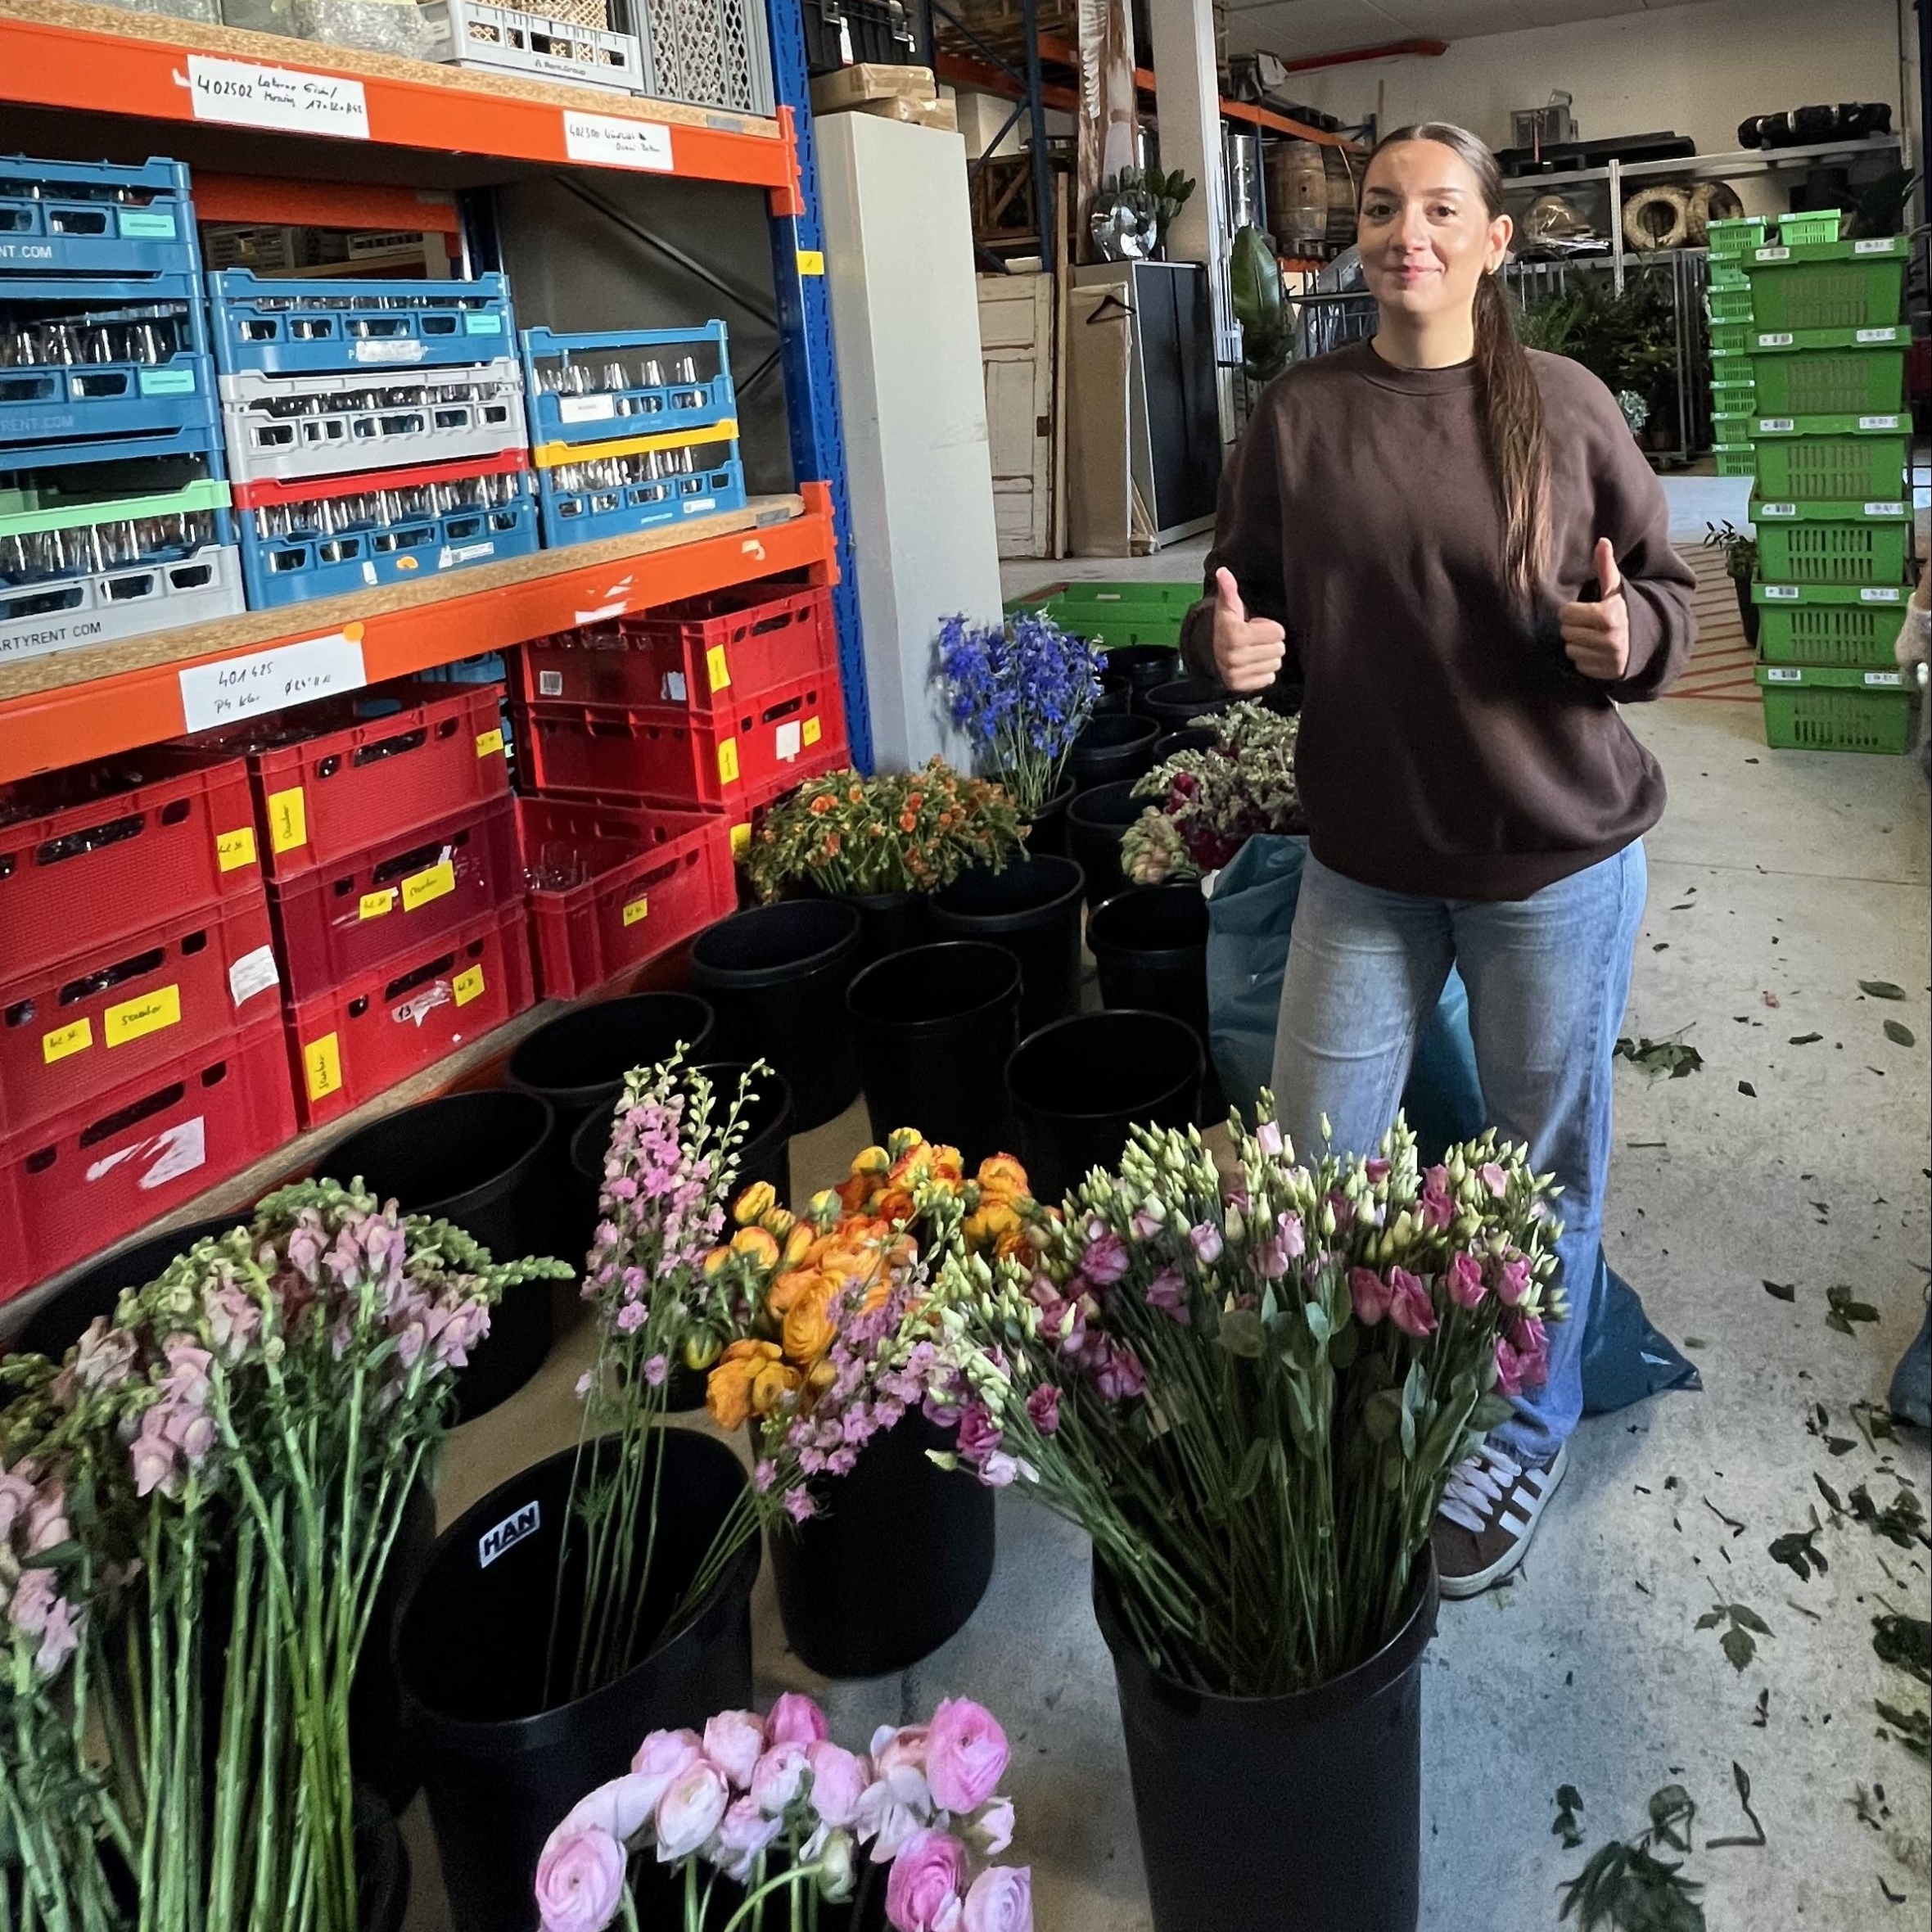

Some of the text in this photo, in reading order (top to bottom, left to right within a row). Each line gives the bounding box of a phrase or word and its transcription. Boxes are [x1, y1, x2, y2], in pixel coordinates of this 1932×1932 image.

[197, 74, 253, 98] 402502
[0, 628, 66, 652] RTYRENT
[483, 1506, 536, 1557] HAN
